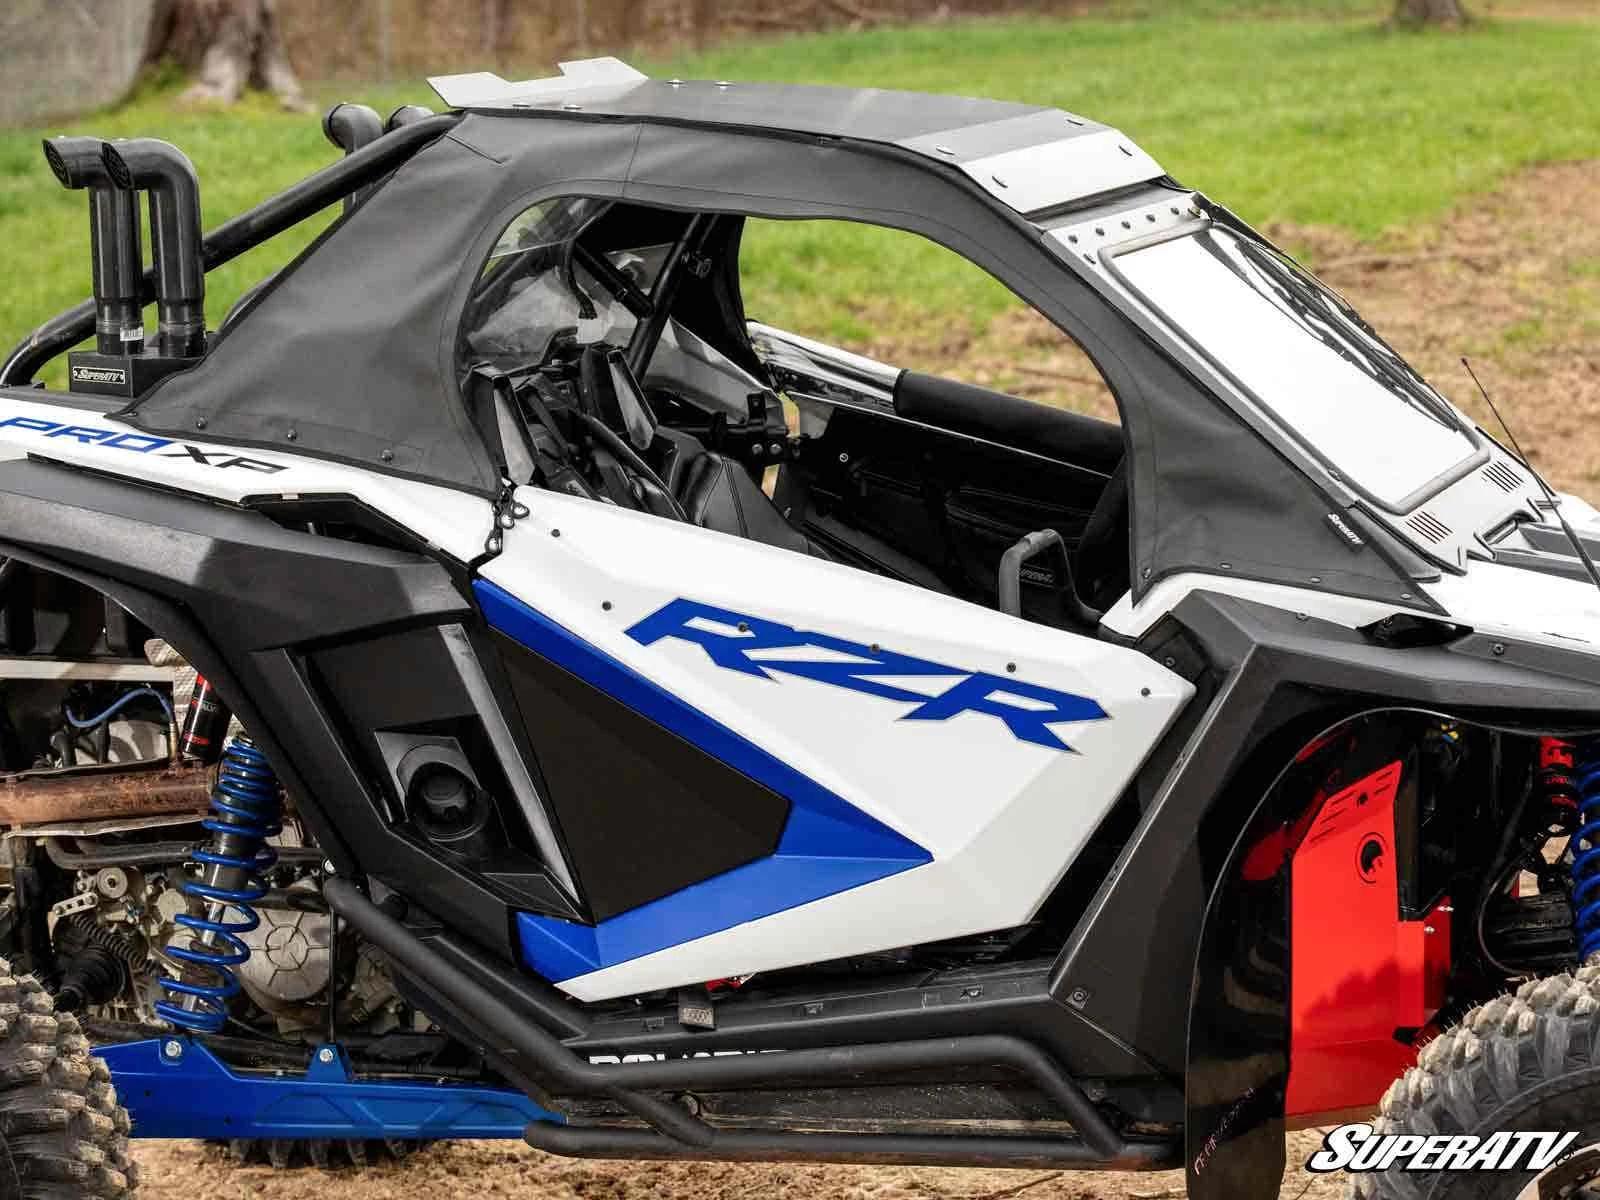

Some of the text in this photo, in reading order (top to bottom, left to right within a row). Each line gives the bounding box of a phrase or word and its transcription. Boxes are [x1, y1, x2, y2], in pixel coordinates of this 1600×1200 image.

[0, 417, 290, 474] PRO XP
[623, 597, 1112, 754] RZR
